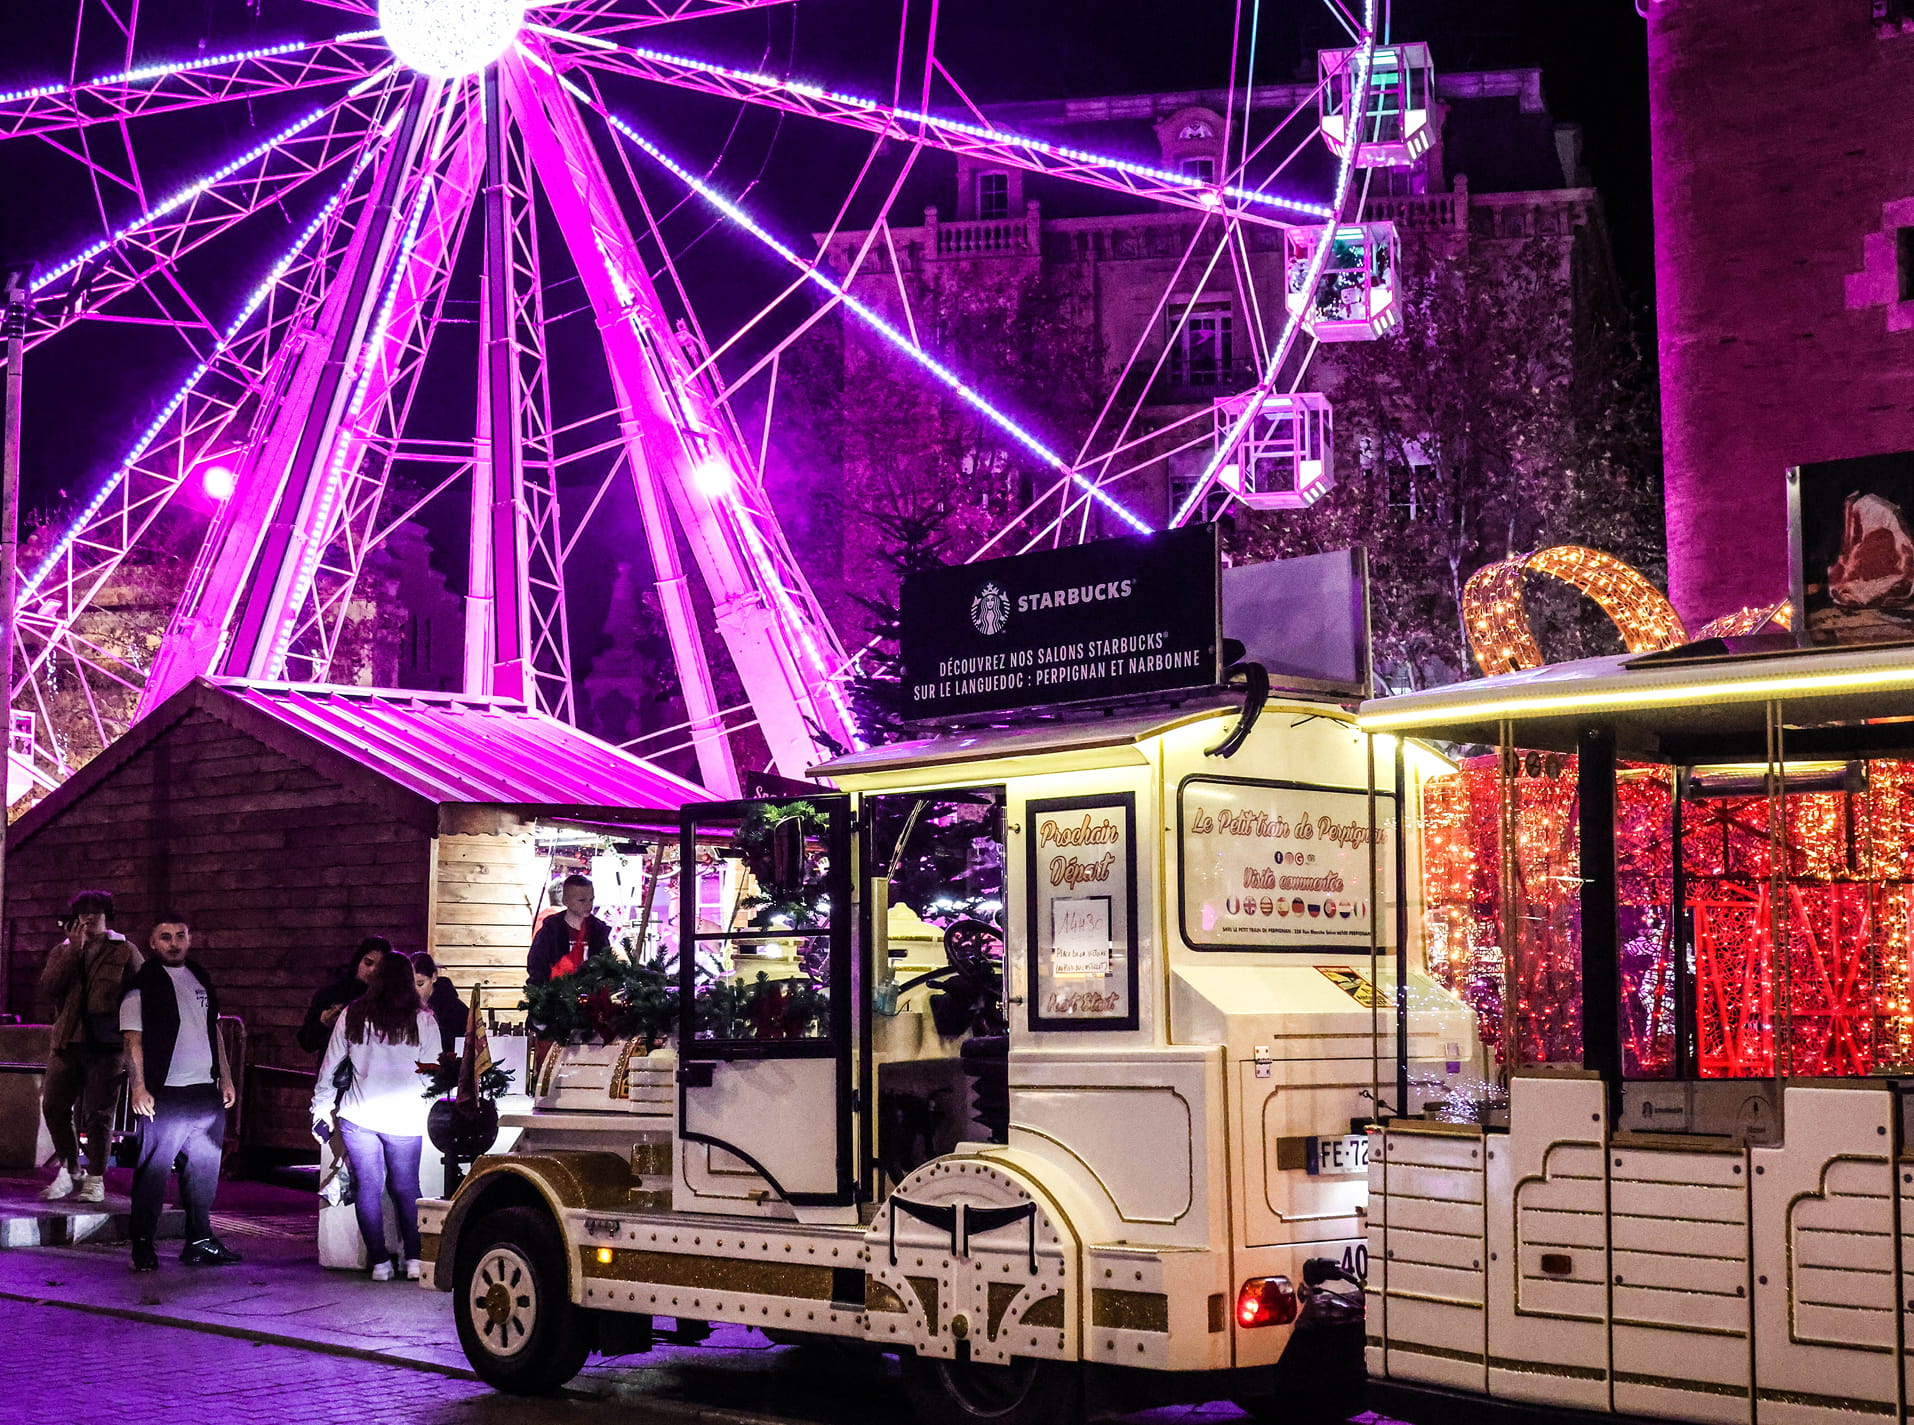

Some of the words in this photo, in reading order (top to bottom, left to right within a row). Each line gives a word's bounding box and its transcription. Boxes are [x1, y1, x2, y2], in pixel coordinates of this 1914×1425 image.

[914, 684, 936, 701] SUR
[940, 682, 951, 697] LE
[955, 672, 1023, 696] LANGUEDOC
[1036, 662, 1105, 686] PERPIGNAN
[1111, 660, 1124, 677] ET
[1129, 650, 1200, 674] NARBONNE
[939, 654, 1006, 677] DÉCOUVREZ
[1010, 650, 1033, 668] NOS
[1038, 643, 1084, 664] SALONS
[1040, 814, 1119, 848] Prochain
[1192, 807, 1214, 834] Le
[1217, 809, 1257, 836] Petit
[1255, 811, 1290, 838] train
[1294, 811, 1313, 840] de
[1050, 851, 1115, 890] Départ
